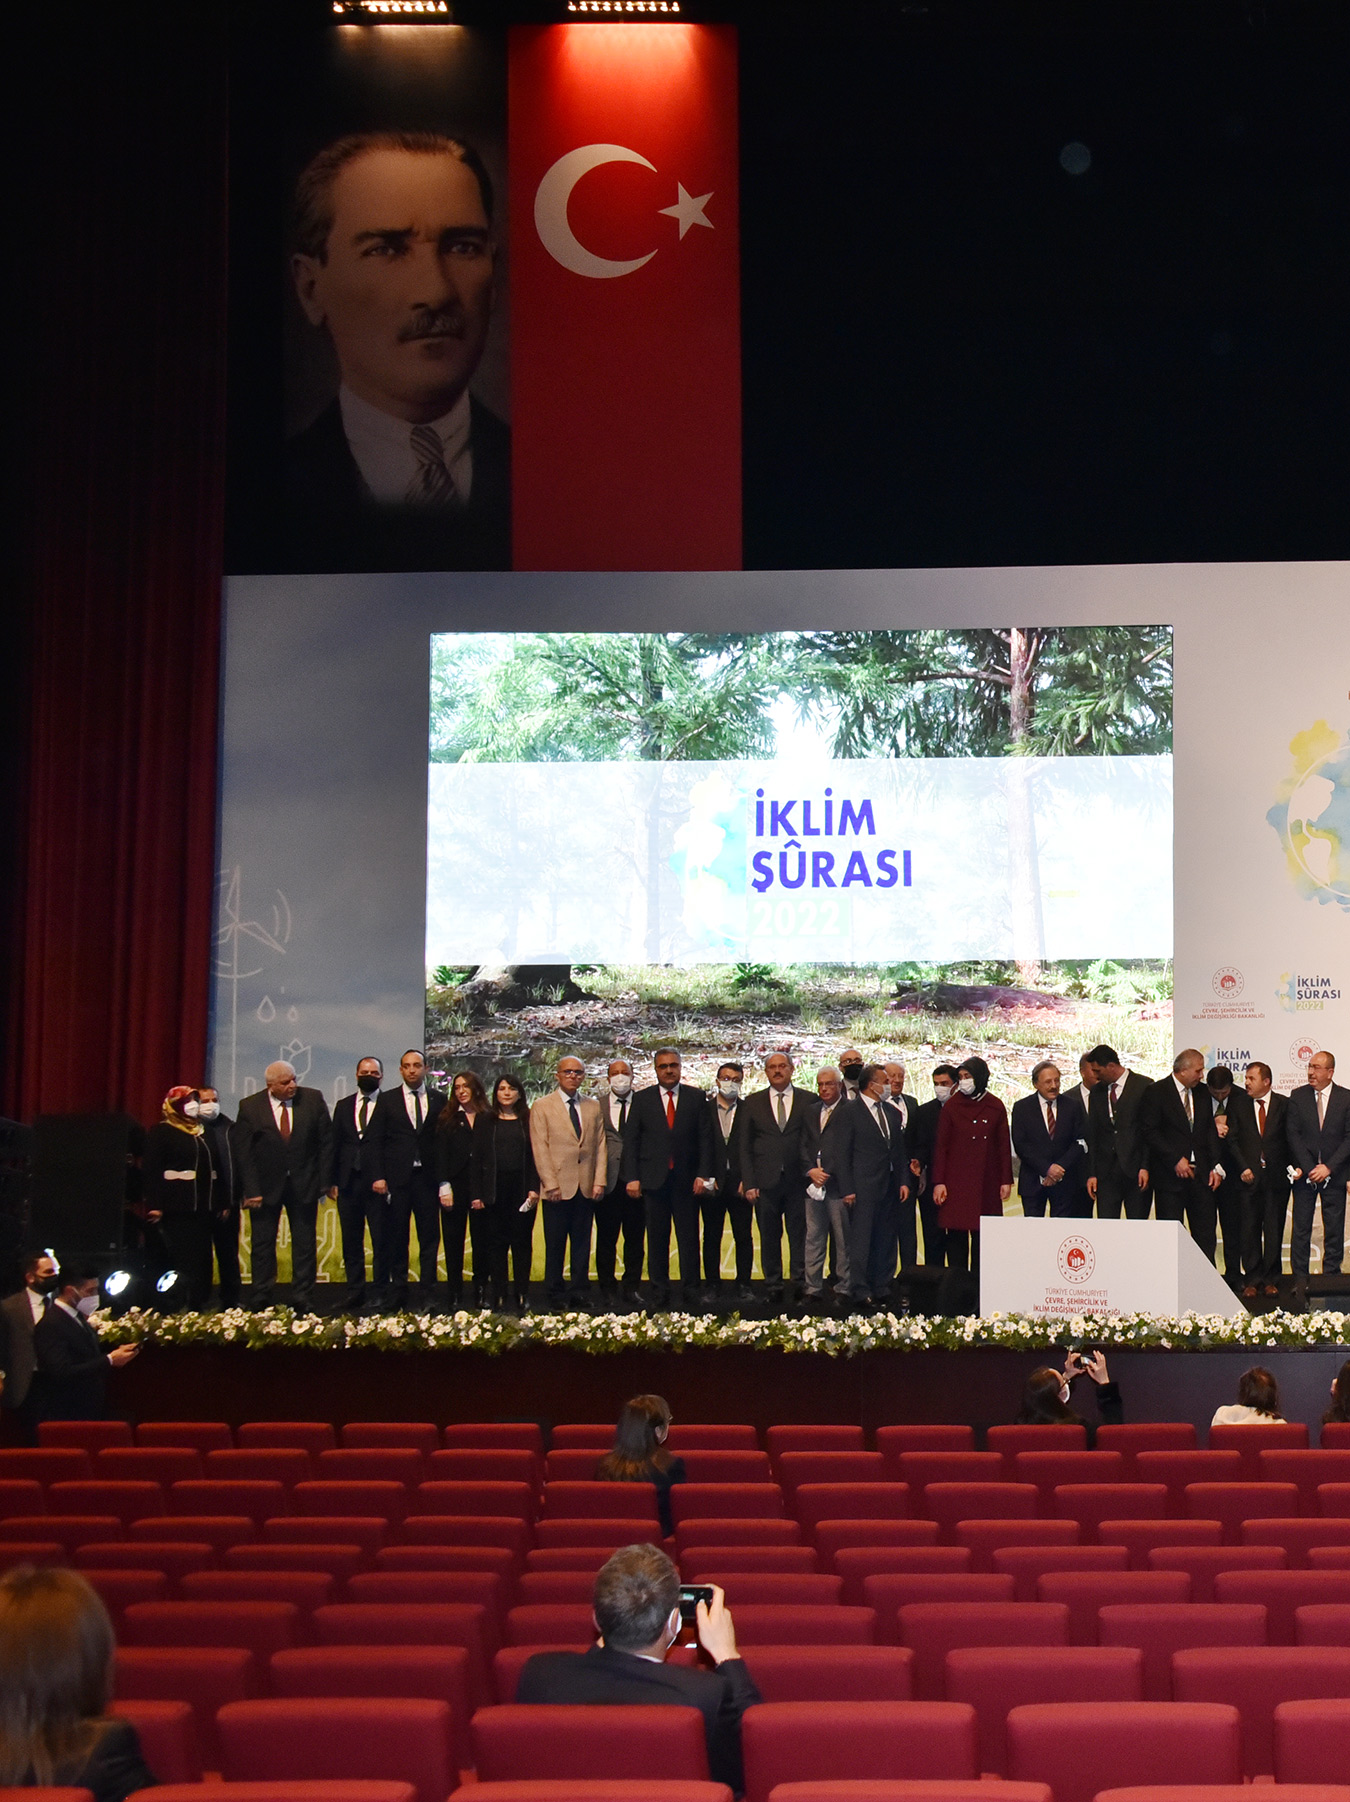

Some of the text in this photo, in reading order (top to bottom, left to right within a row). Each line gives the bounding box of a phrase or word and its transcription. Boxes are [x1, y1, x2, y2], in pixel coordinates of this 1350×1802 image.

[755, 787, 876, 837] İKLİM
[751, 839, 912, 893] ŞÛRASI
[753, 899, 840, 936] 2022
[1297, 975, 1331, 987] İKLİM
[1297, 988, 1341, 1000] ŞÛRASI
[1297, 1001, 1322, 1010] 2022
[1217, 1048, 1251, 1060] İKLİM
